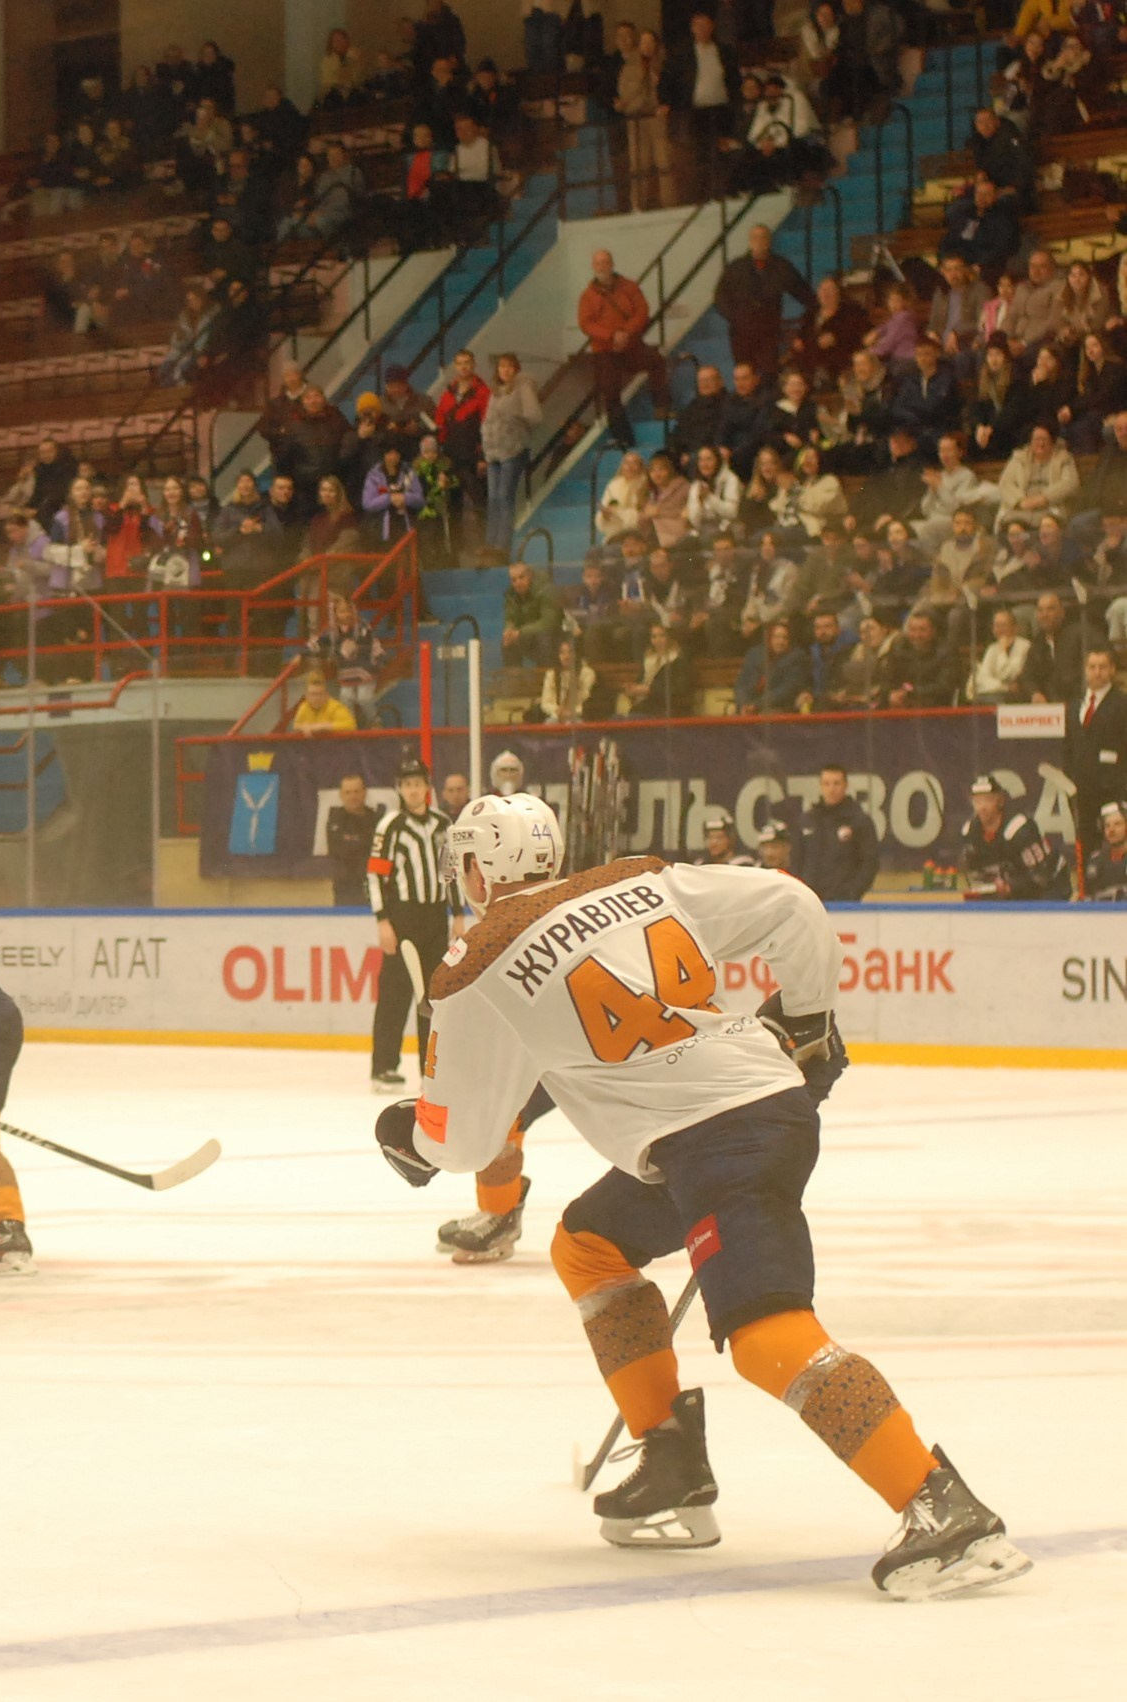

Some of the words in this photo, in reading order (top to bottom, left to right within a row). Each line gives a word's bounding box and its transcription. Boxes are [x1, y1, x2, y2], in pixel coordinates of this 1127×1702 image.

[1000, 715, 1061, 727] OLIMPBET
[532, 824, 552, 840] 44
[90, 938, 168, 979] АГАТ
[506, 885, 665, 997] ЖУРАВЛЕВ
[222, 945, 384, 1003] OLIM
[564, 914, 724, 1064] 44
